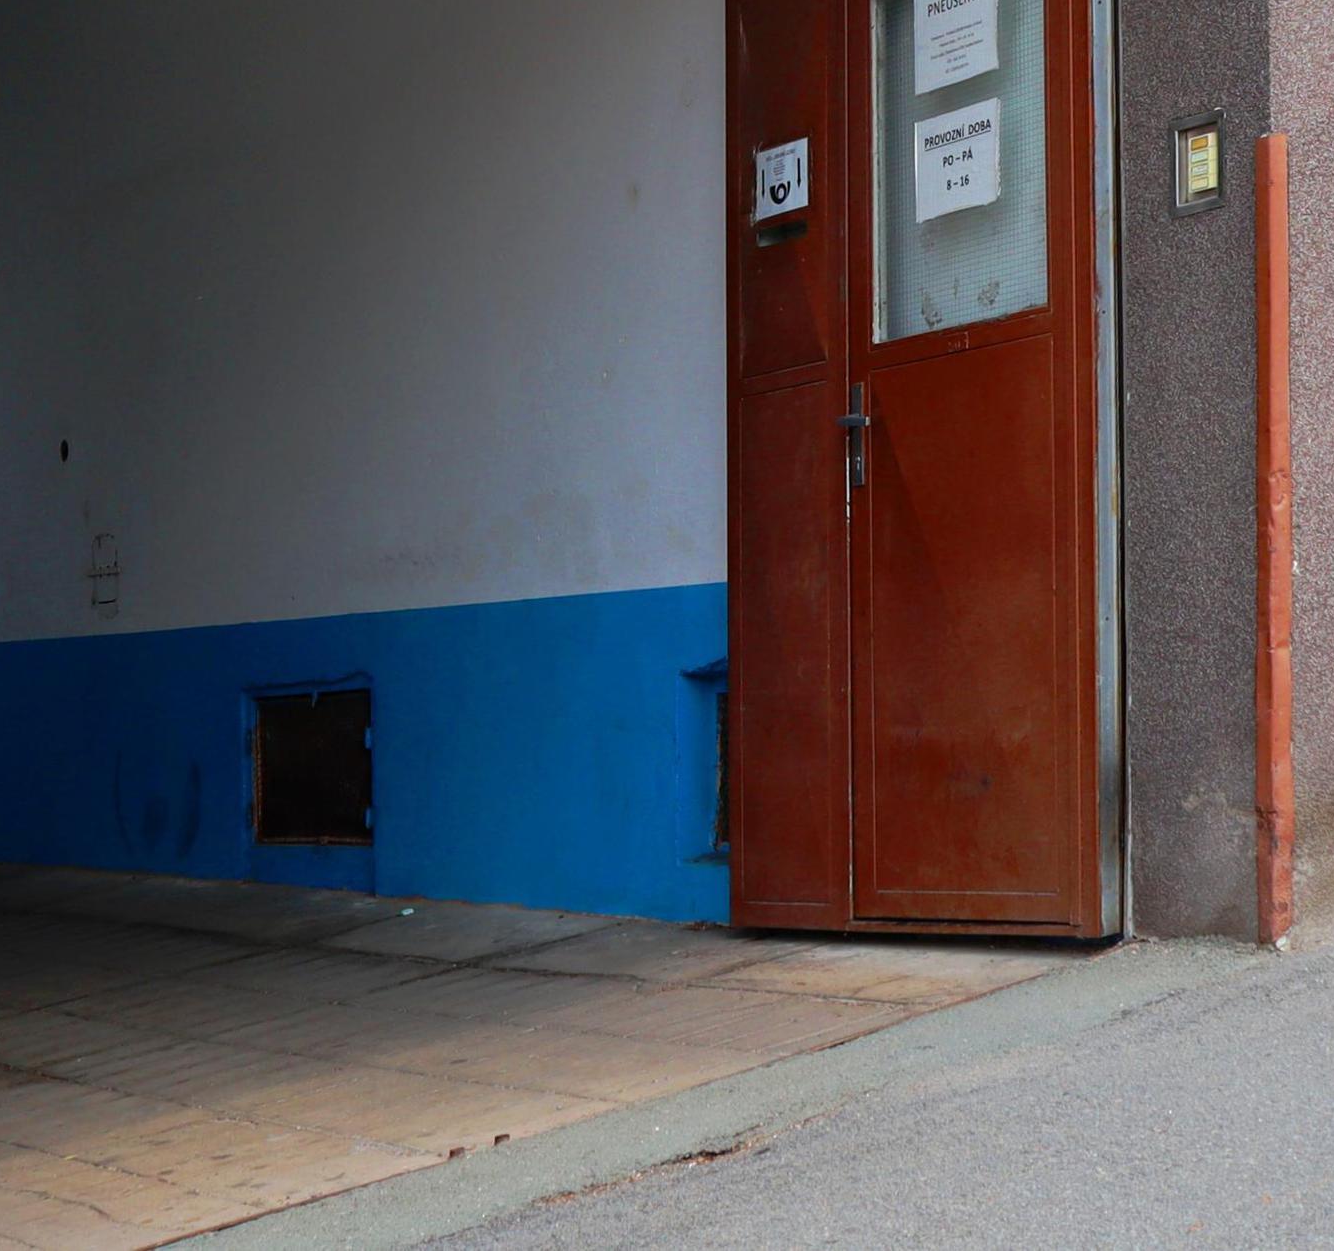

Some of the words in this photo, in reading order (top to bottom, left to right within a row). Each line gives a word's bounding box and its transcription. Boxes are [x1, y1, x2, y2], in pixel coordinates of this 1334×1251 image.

[924, 123, 965, 149] PROVOZNÍ
[968, 119, 992, 136] DOBA
[943, 154, 954, 168] PO
[946, 179, 952, 191] 8
[960, 174, 970, 187] 16
